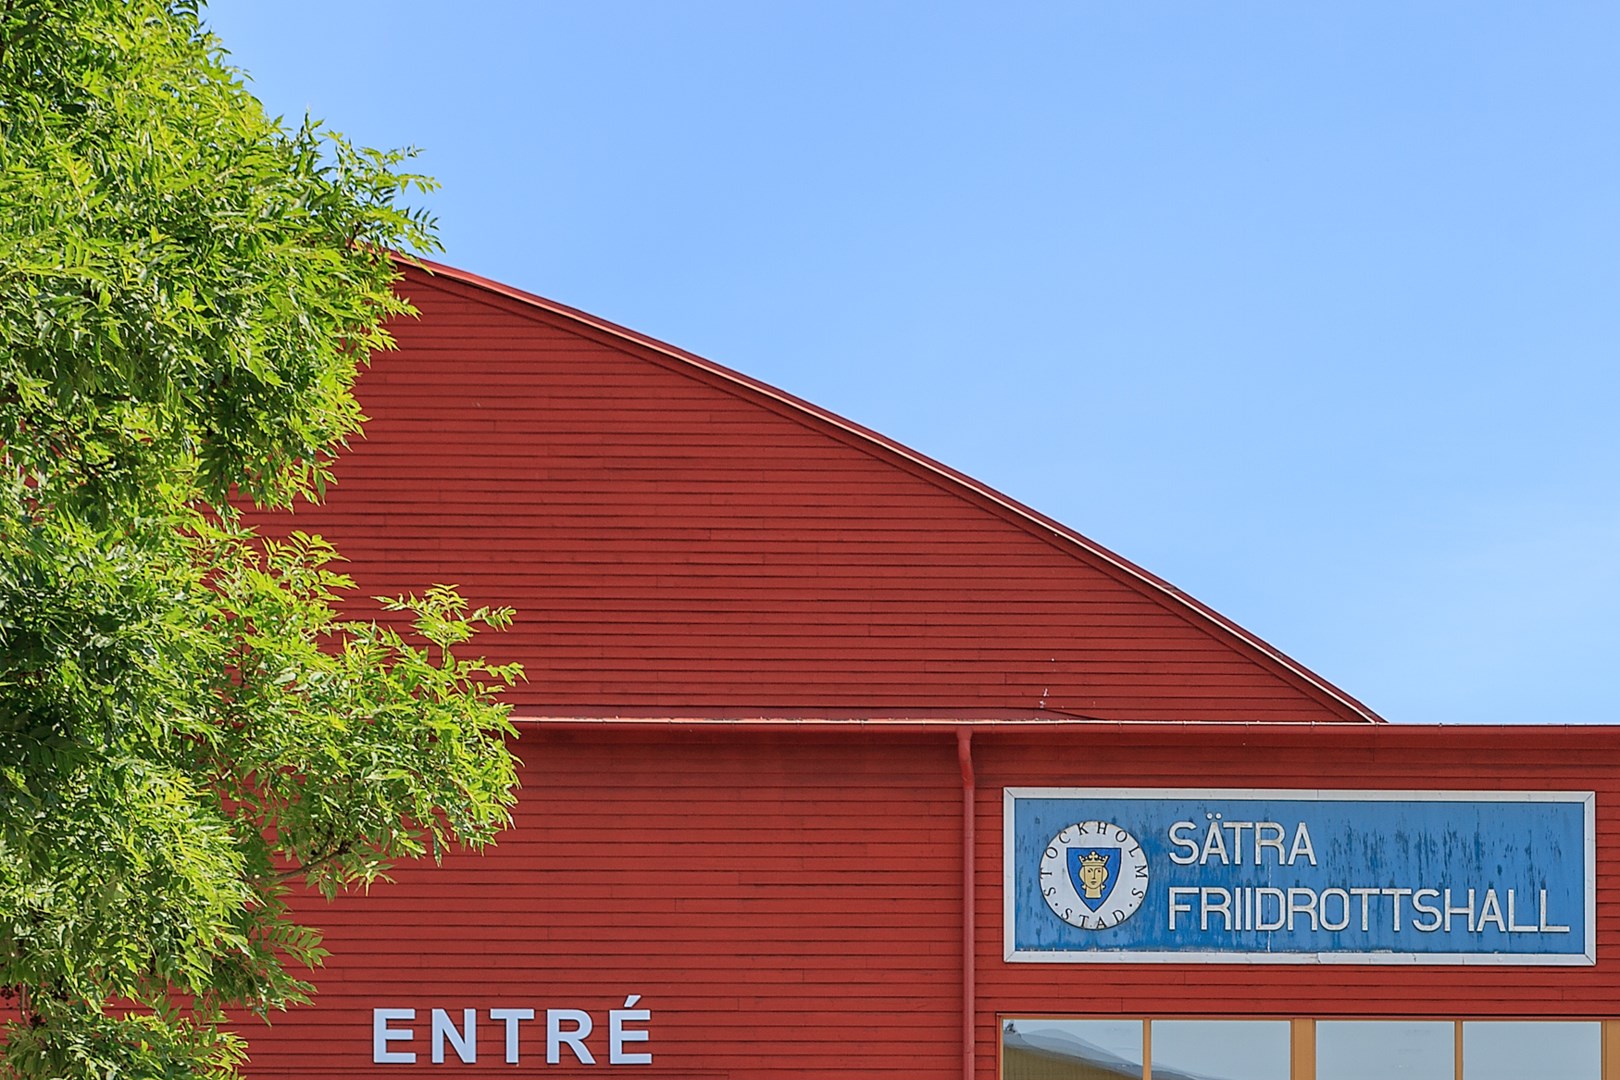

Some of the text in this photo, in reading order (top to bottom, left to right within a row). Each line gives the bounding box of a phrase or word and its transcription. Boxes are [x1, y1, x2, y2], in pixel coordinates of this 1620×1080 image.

[1040, 821, 1148, 900] STOCKHOLMS
[1168, 813, 1317, 865] SÄTRA
[1061, 907, 1126, 930] STAD
[1168, 886, 1571, 933] FRIIDROTTSHALL
[372, 994, 654, 1066] ENTRÉ
